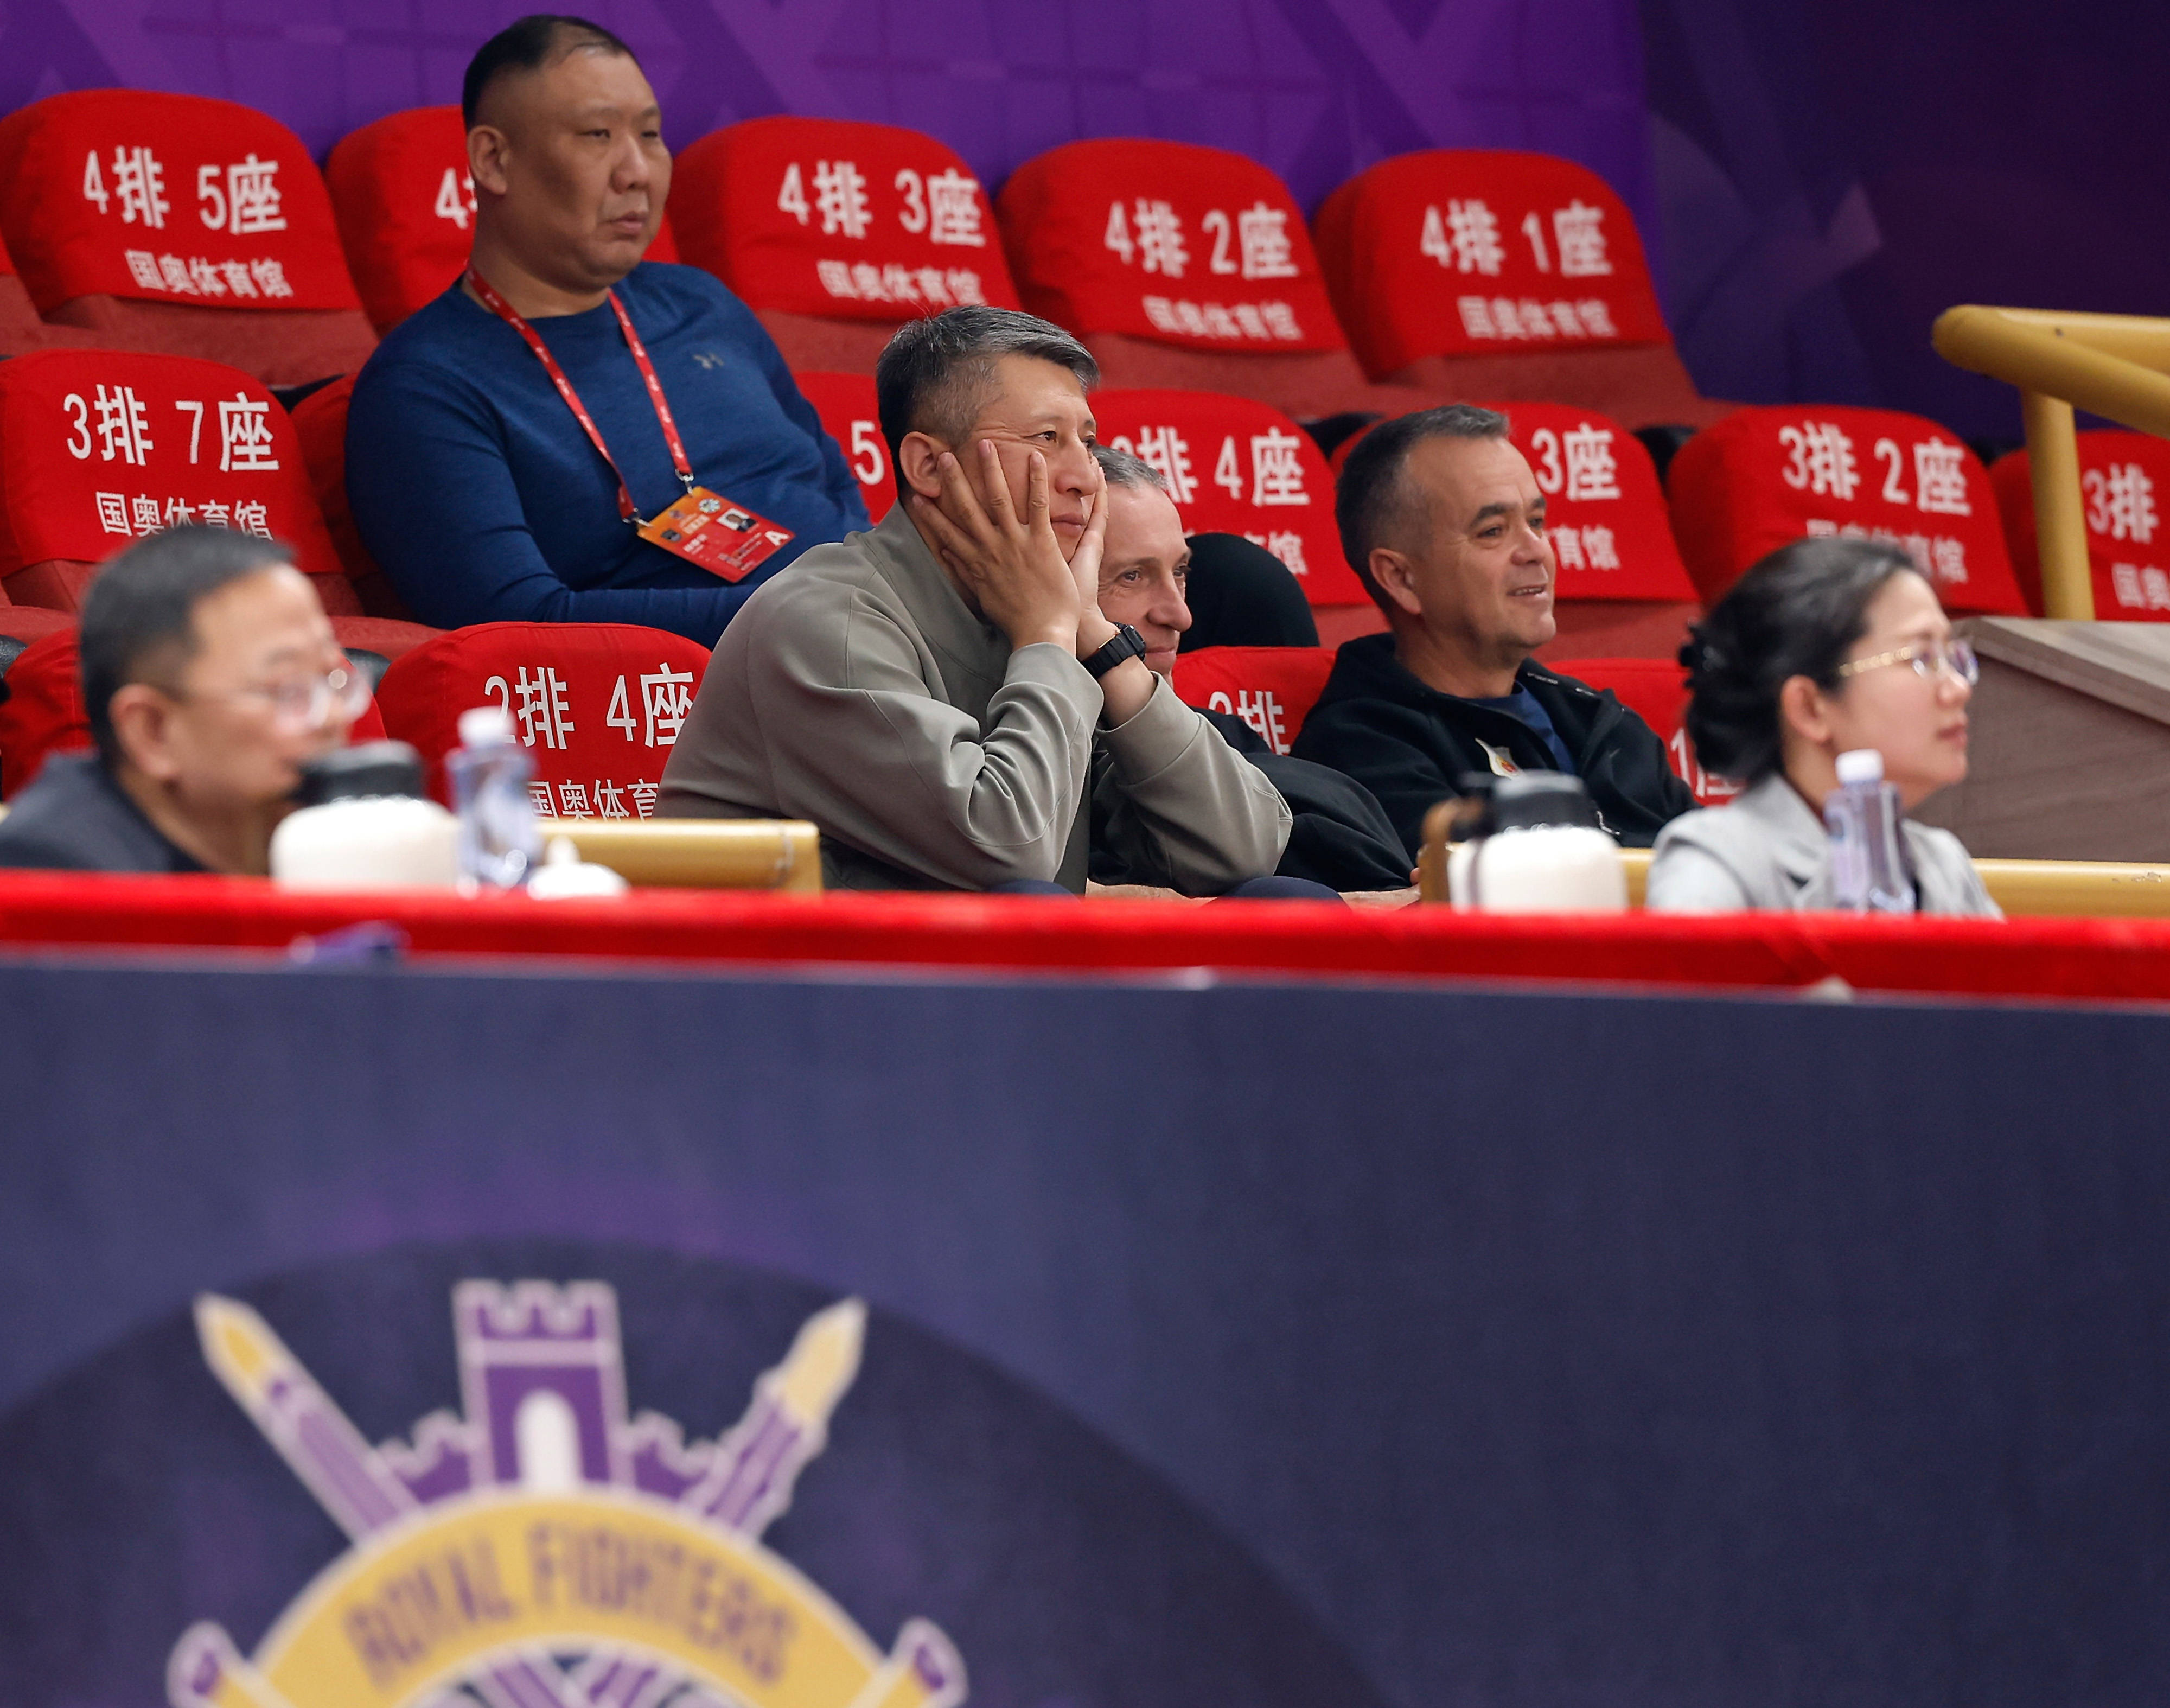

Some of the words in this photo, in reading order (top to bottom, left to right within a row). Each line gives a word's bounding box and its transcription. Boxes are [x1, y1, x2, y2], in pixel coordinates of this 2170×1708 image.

[83, 145, 170, 230] 4排
[197, 153, 288, 235] 5座
[435, 165, 478, 230] 4
[777, 160, 872, 239] 4排
[895, 167, 986, 247] 3座
[124, 249, 293, 298] 国奥体育馆
[1105, 197, 1190, 278] 4排
[1202, 201, 1299, 280] 2座
[1420, 198, 1505, 276] 4排
[1521, 199, 1613, 277] 1座
[63, 384, 154, 466] 3排
[175, 392, 279, 473] 7座
[1214, 426, 1310, 507] 4座
[1531, 422, 1621, 502] 3座
[1779, 421, 1860, 501] 3排
[1875, 438, 1971, 516] 2座
[2083, 463, 2158, 543] 3排
[606, 662, 694, 748] 4座
